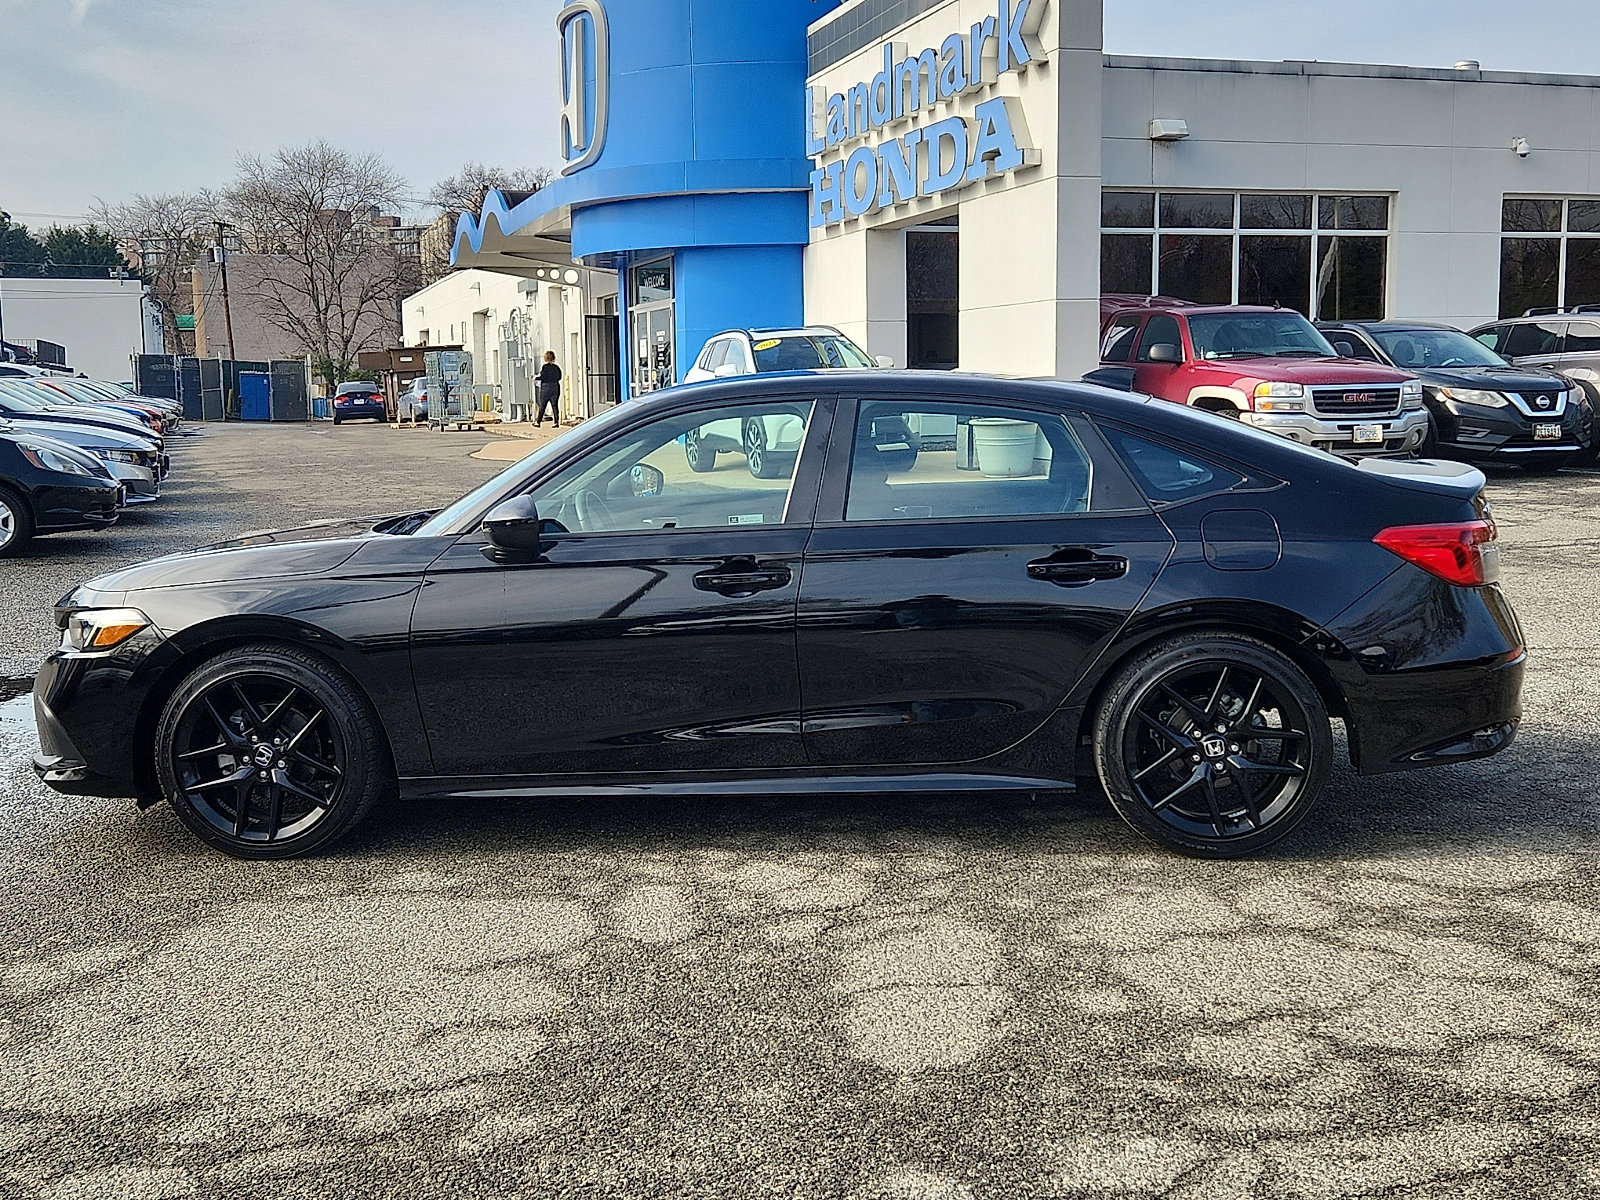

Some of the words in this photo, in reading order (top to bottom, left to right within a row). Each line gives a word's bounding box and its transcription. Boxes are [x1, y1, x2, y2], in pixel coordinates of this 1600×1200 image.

[806, 0, 1036, 157] Landmark
[809, 95, 1026, 228] HONDA
[643, 273, 665, 288] WELCOME
[1343, 392, 1376, 403] GMC
